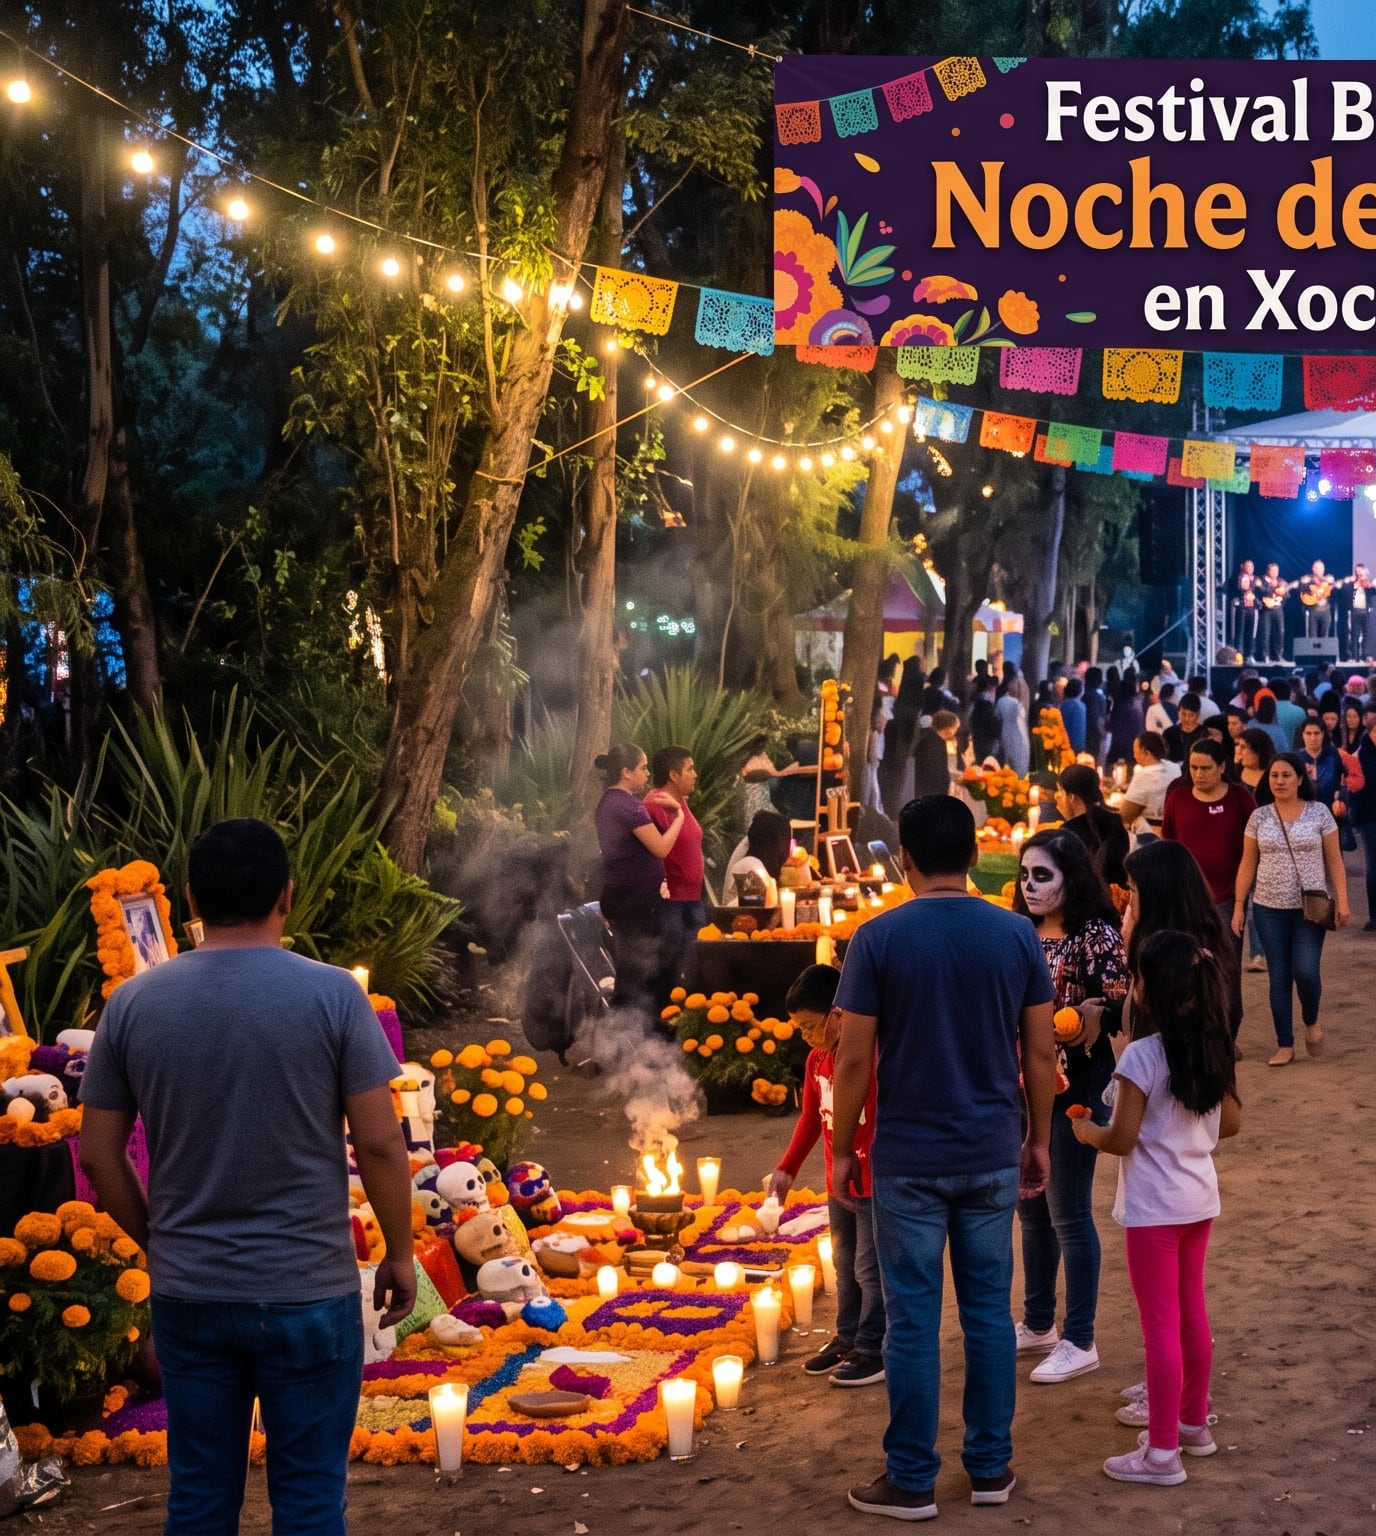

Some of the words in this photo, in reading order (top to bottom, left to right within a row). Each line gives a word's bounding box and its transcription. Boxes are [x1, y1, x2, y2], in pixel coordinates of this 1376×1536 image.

[1045, 77, 1310, 142] Festival
[931, 155, 1247, 250] Noche
[1143, 284, 1227, 332] en
